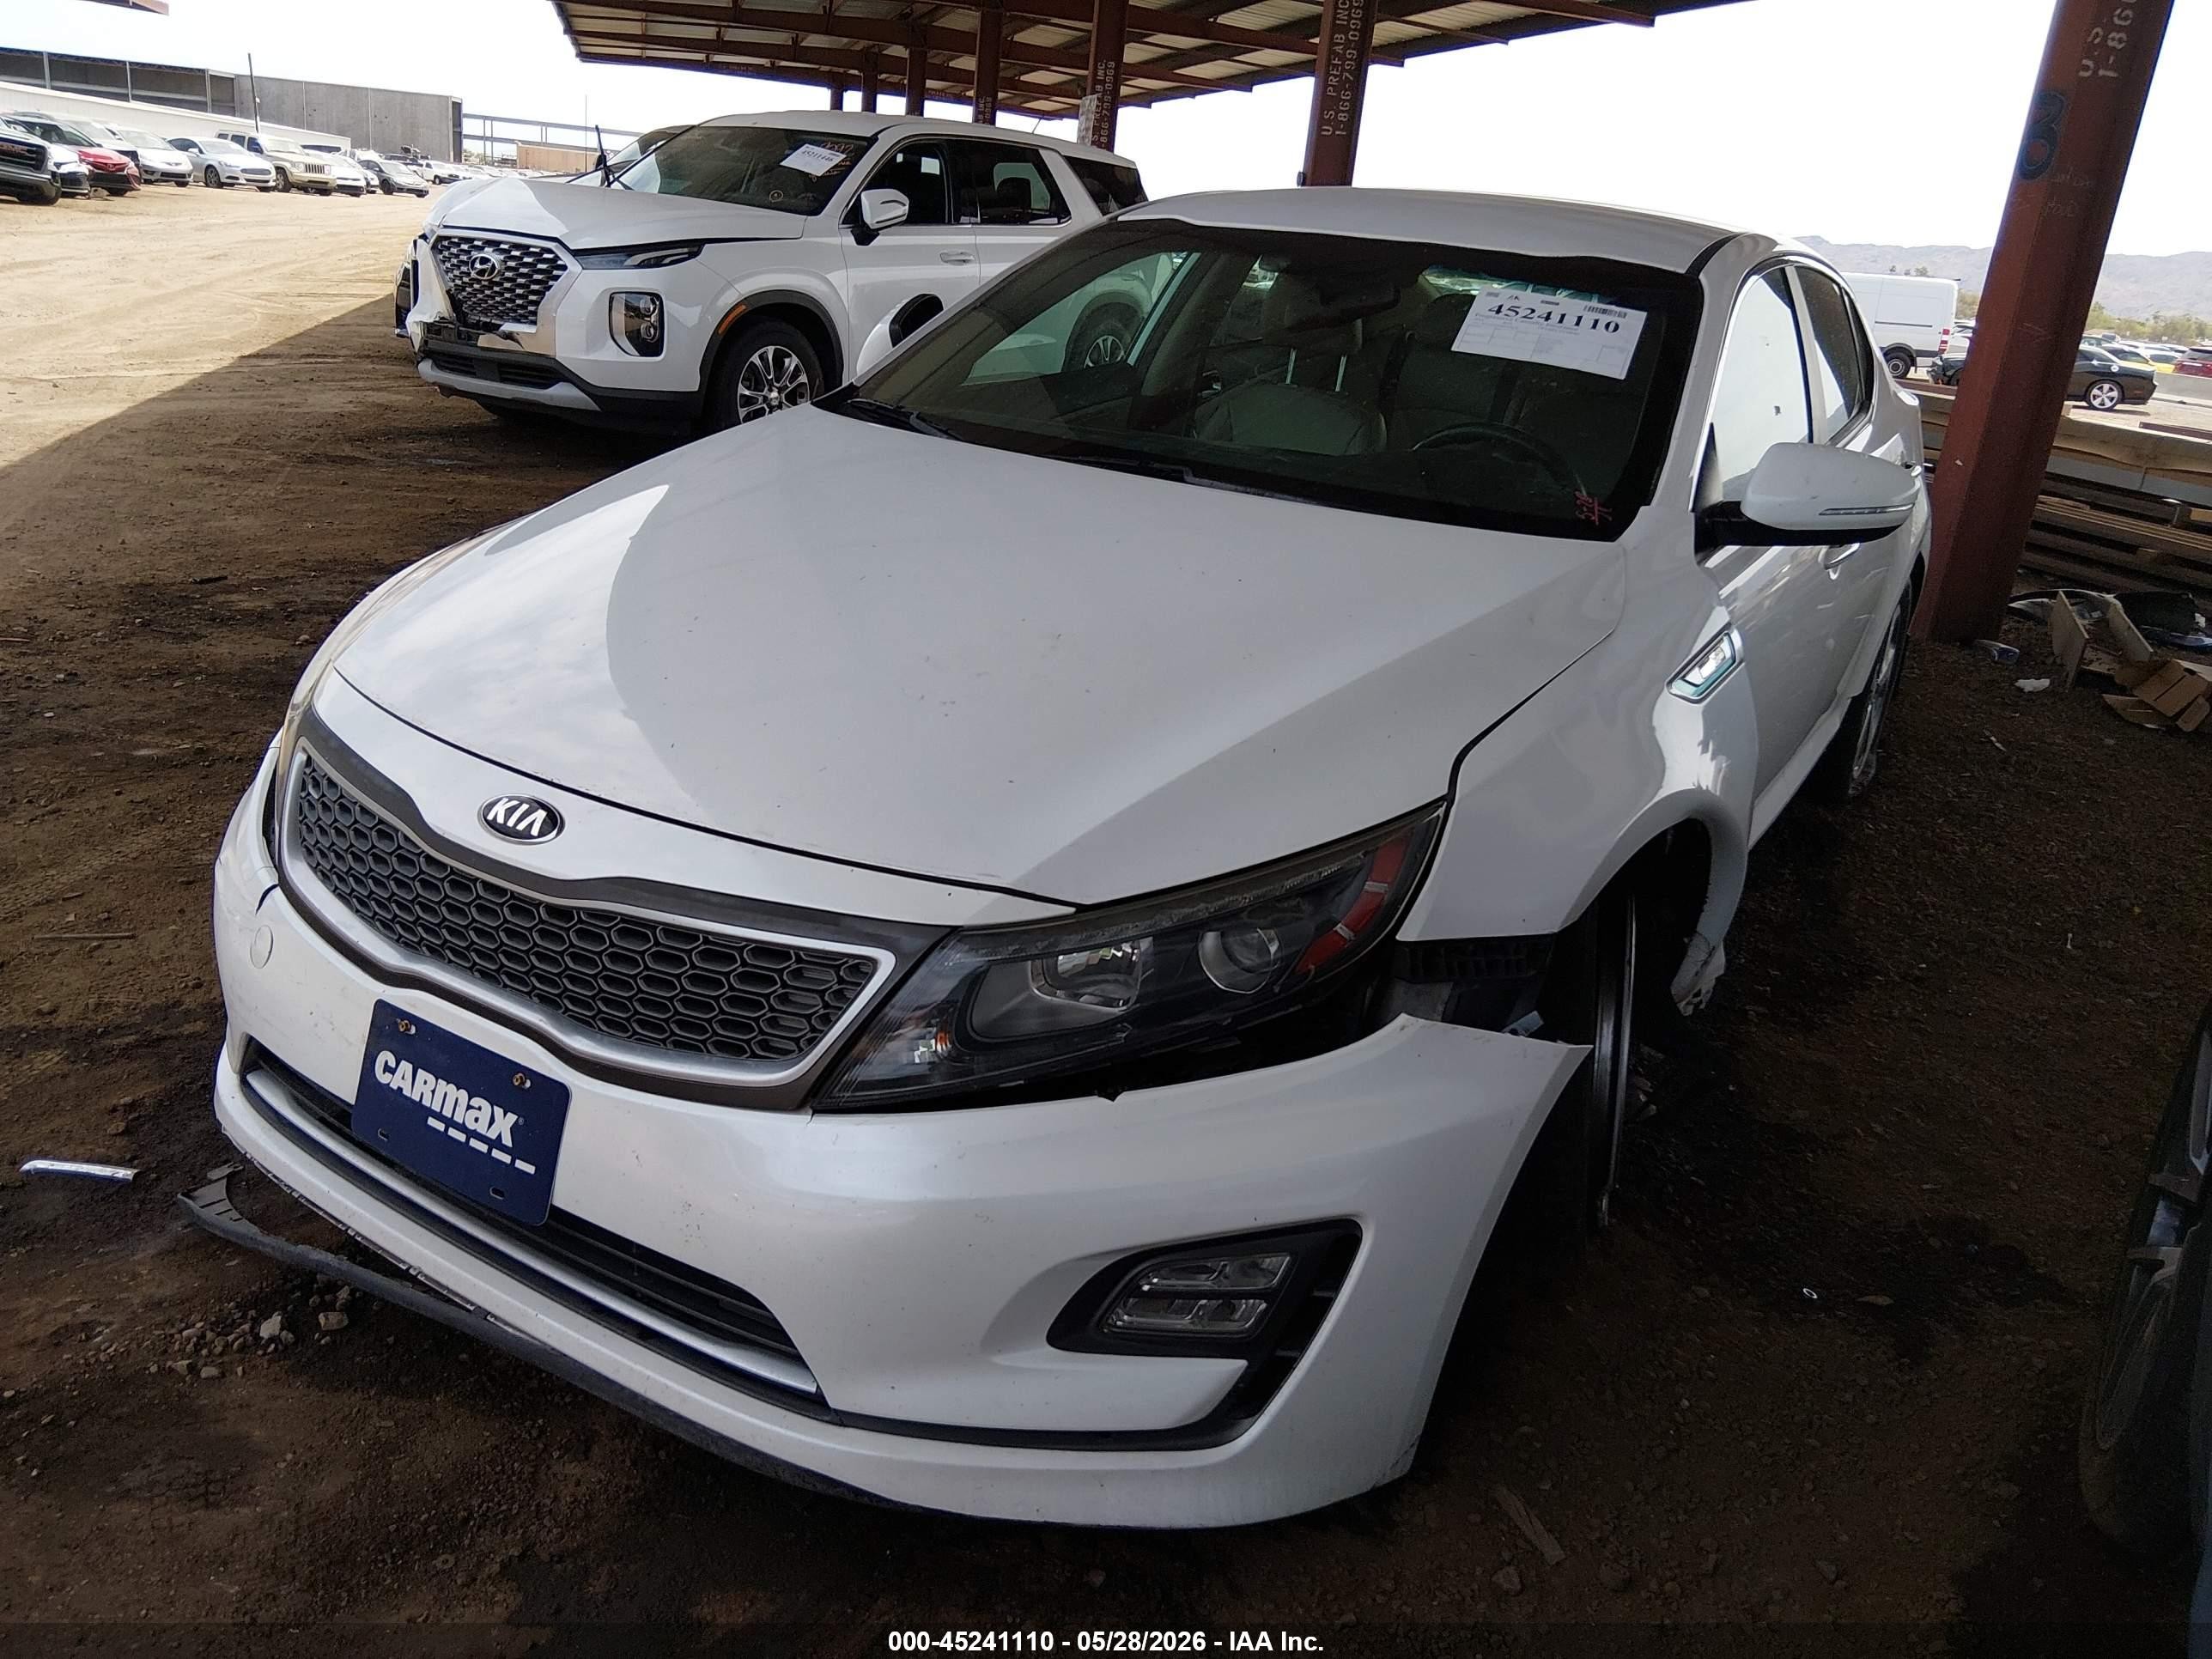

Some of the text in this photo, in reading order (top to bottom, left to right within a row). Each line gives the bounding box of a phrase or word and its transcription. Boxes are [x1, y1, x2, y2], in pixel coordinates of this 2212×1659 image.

[1327, 33, 1346, 96] PREFAB
[1487, 303, 1620, 334] 45241110
[486, 797, 548, 837] KIA
